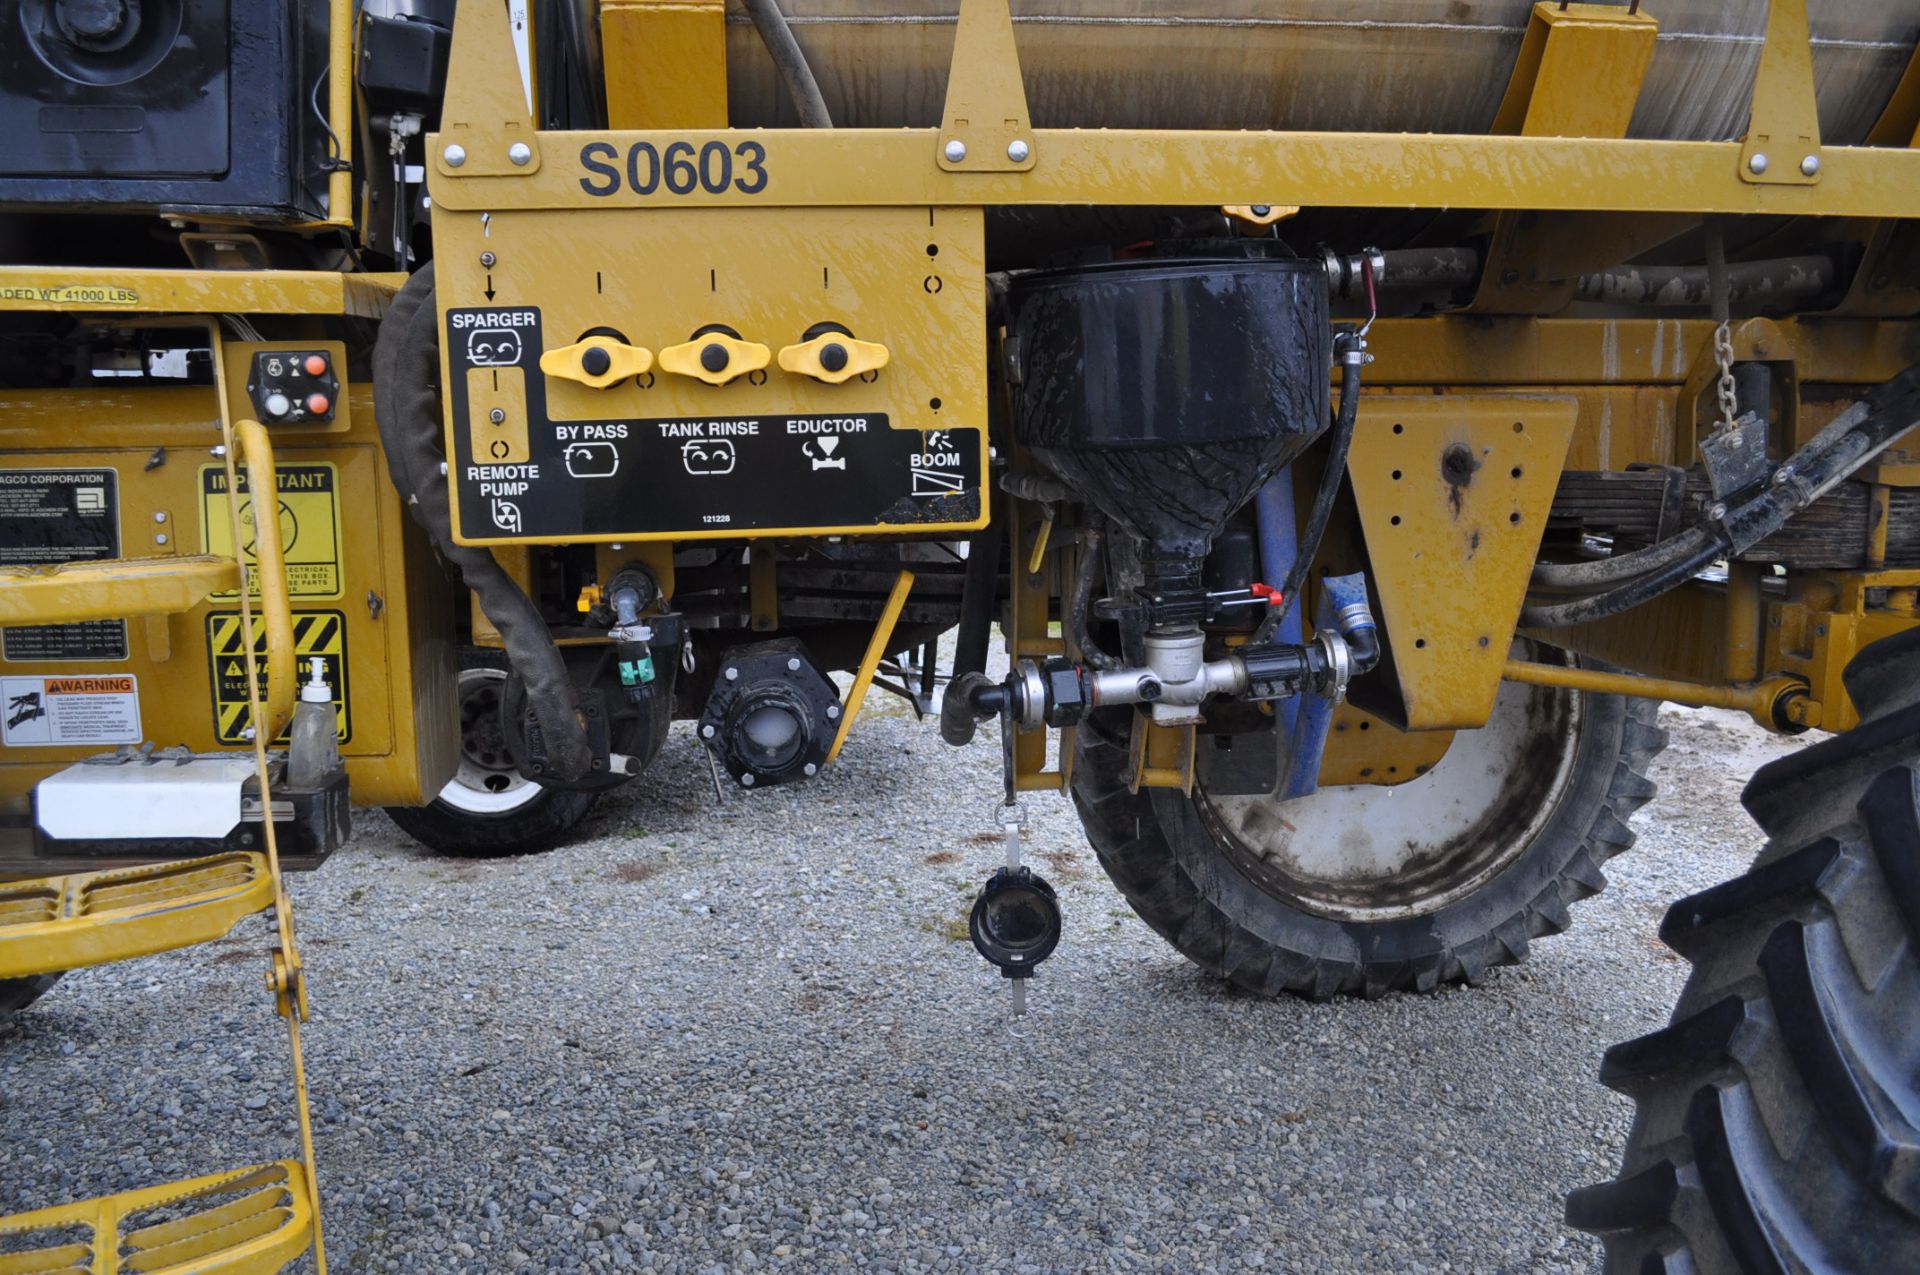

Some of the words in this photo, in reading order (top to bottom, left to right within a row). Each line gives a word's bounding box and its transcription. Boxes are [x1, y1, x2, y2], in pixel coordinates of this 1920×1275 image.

[579, 140, 769, 197] S0603
[65, 290, 104, 301] 41000
[109, 290, 138, 302] LBS
[452, 312, 536, 328] SPARGER
[556, 426, 577, 440] BY
[584, 424, 628, 439] PASS
[658, 423, 704, 437] TANK
[709, 421, 759, 436] RINSE
[787, 418, 867, 434] EDUCTOR
[910, 452, 960, 467] BOOM
[0, 475, 28, 484] AGCO
[30, 474, 104, 484] CORPORATION
[467, 465, 540, 480] REMOTE
[480, 481, 529, 497] PUMP
[61, 679, 131, 692] WARNING
